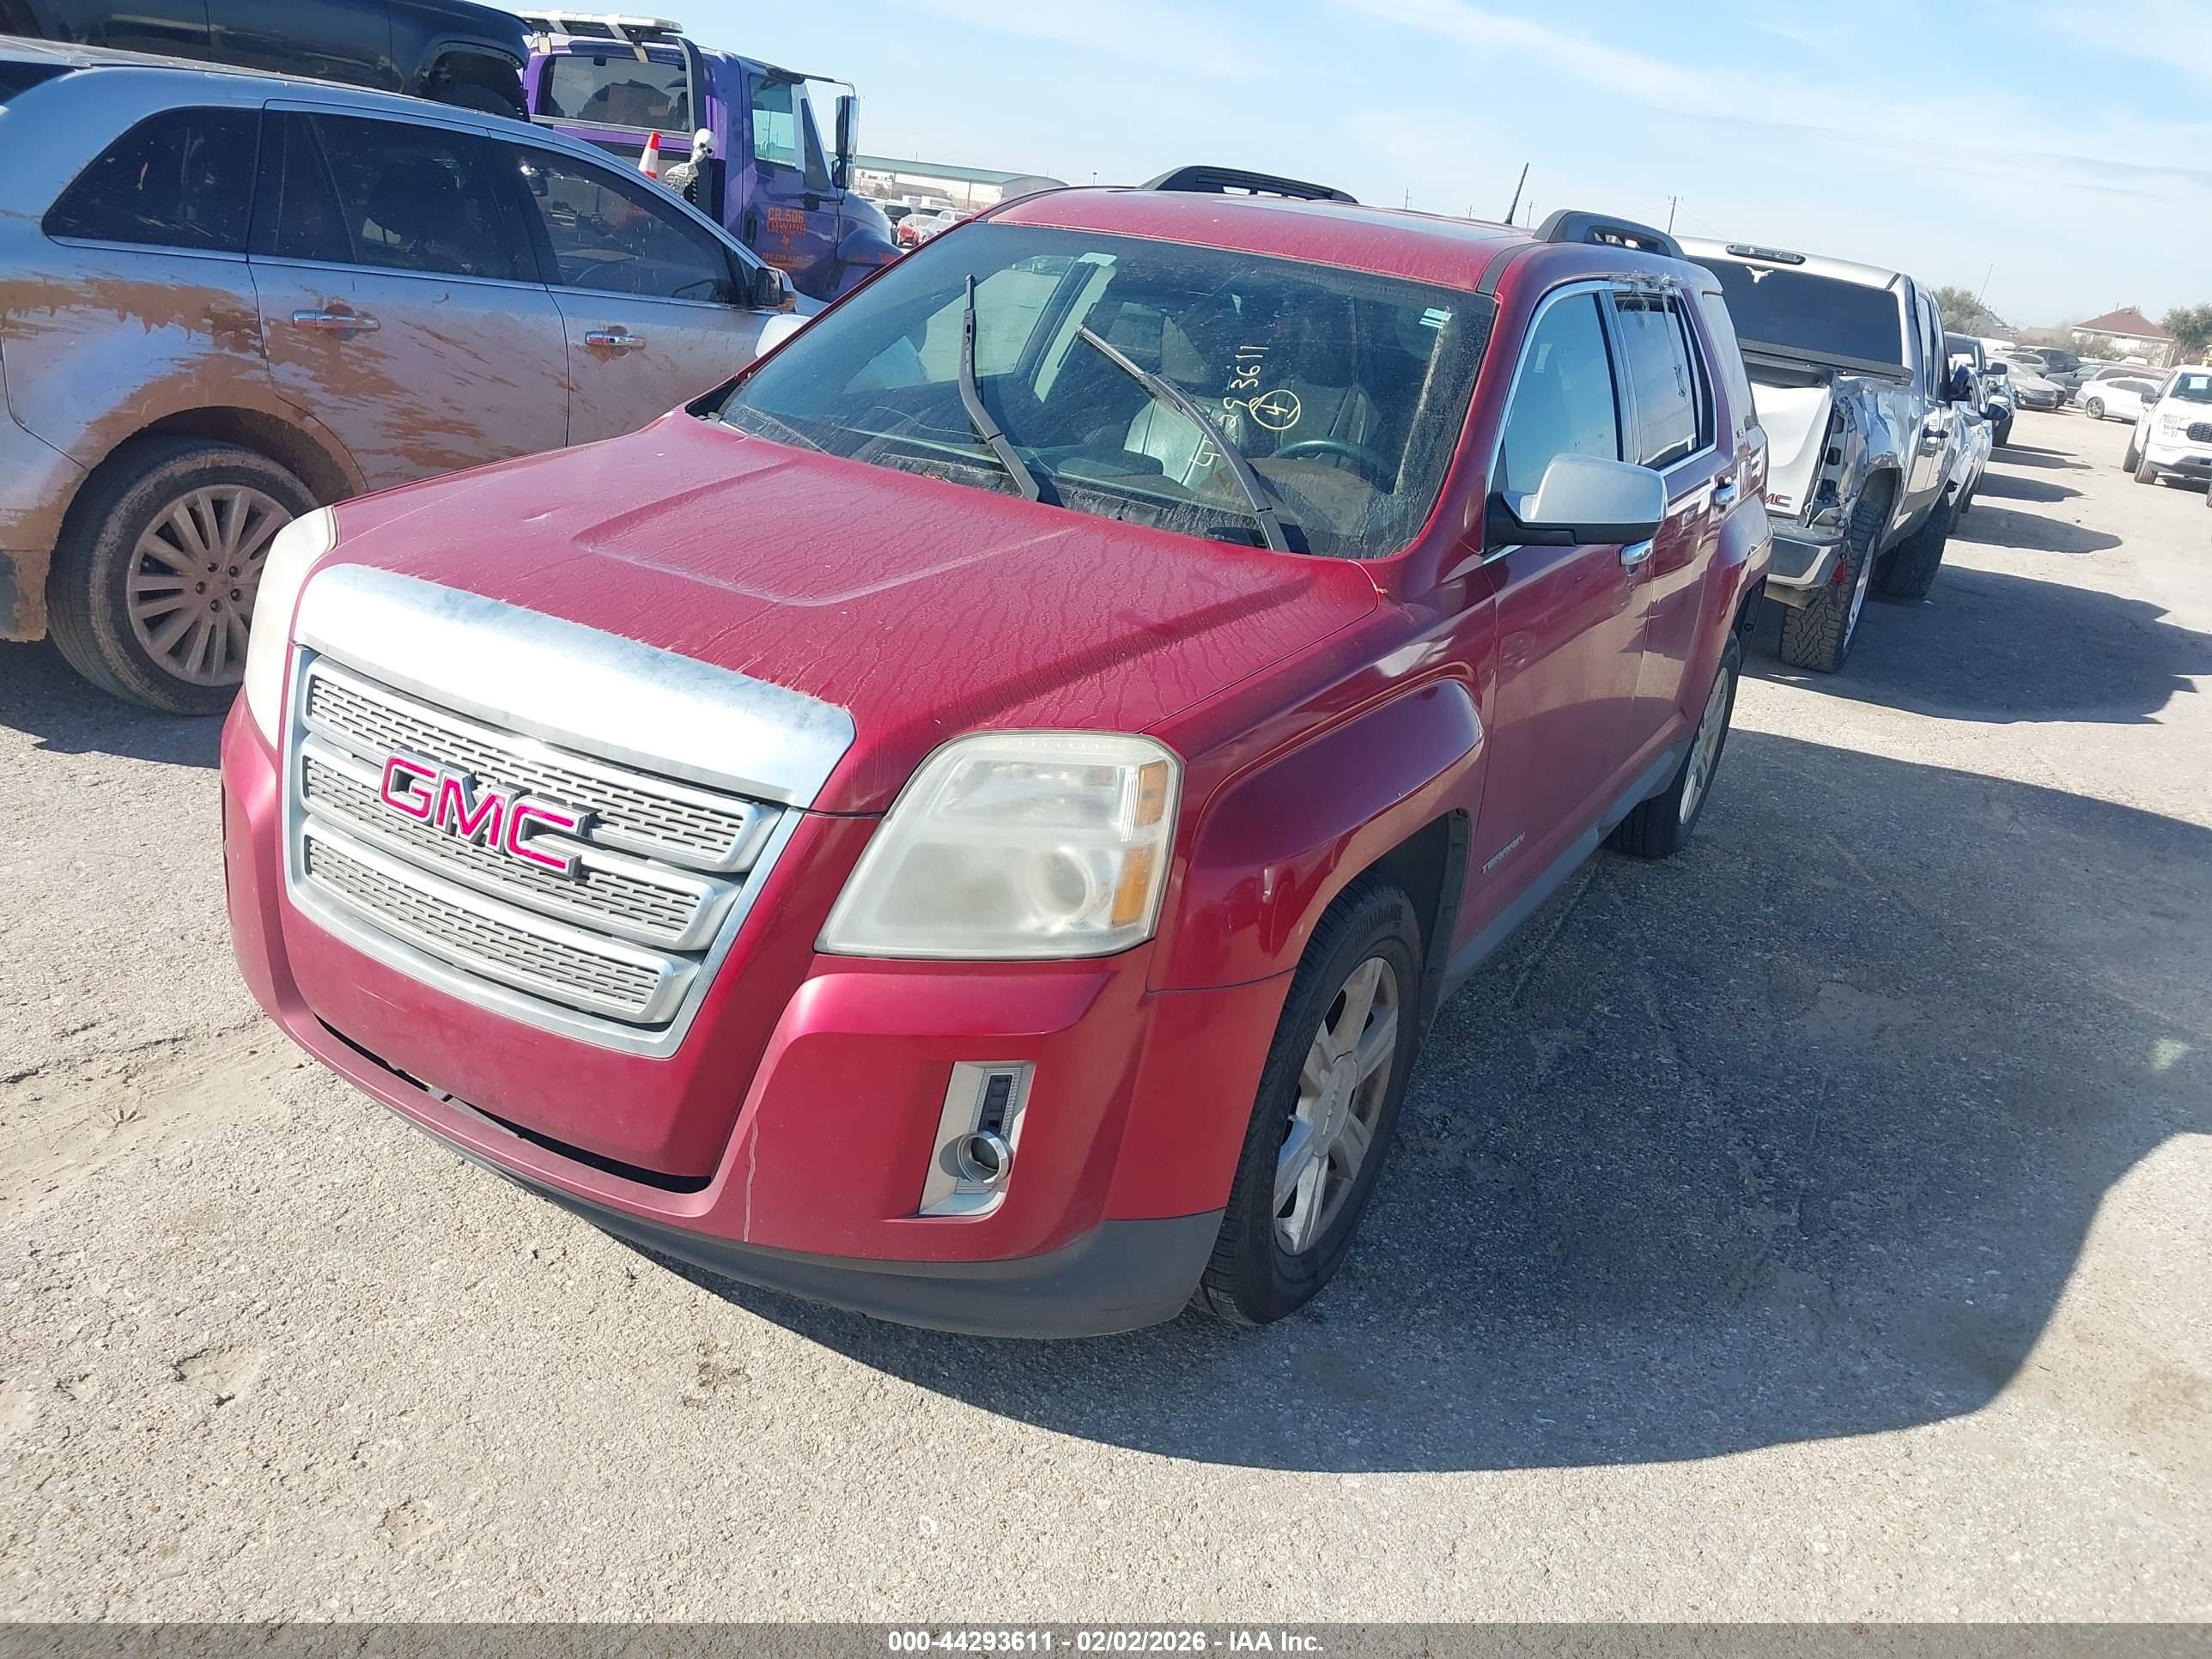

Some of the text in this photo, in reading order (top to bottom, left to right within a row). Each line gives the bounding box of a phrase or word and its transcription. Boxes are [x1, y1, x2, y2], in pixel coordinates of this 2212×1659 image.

[766, 220, 806, 231] TOWING
[1765, 492, 1793, 508] MC
[379, 751, 586, 876] GMC
